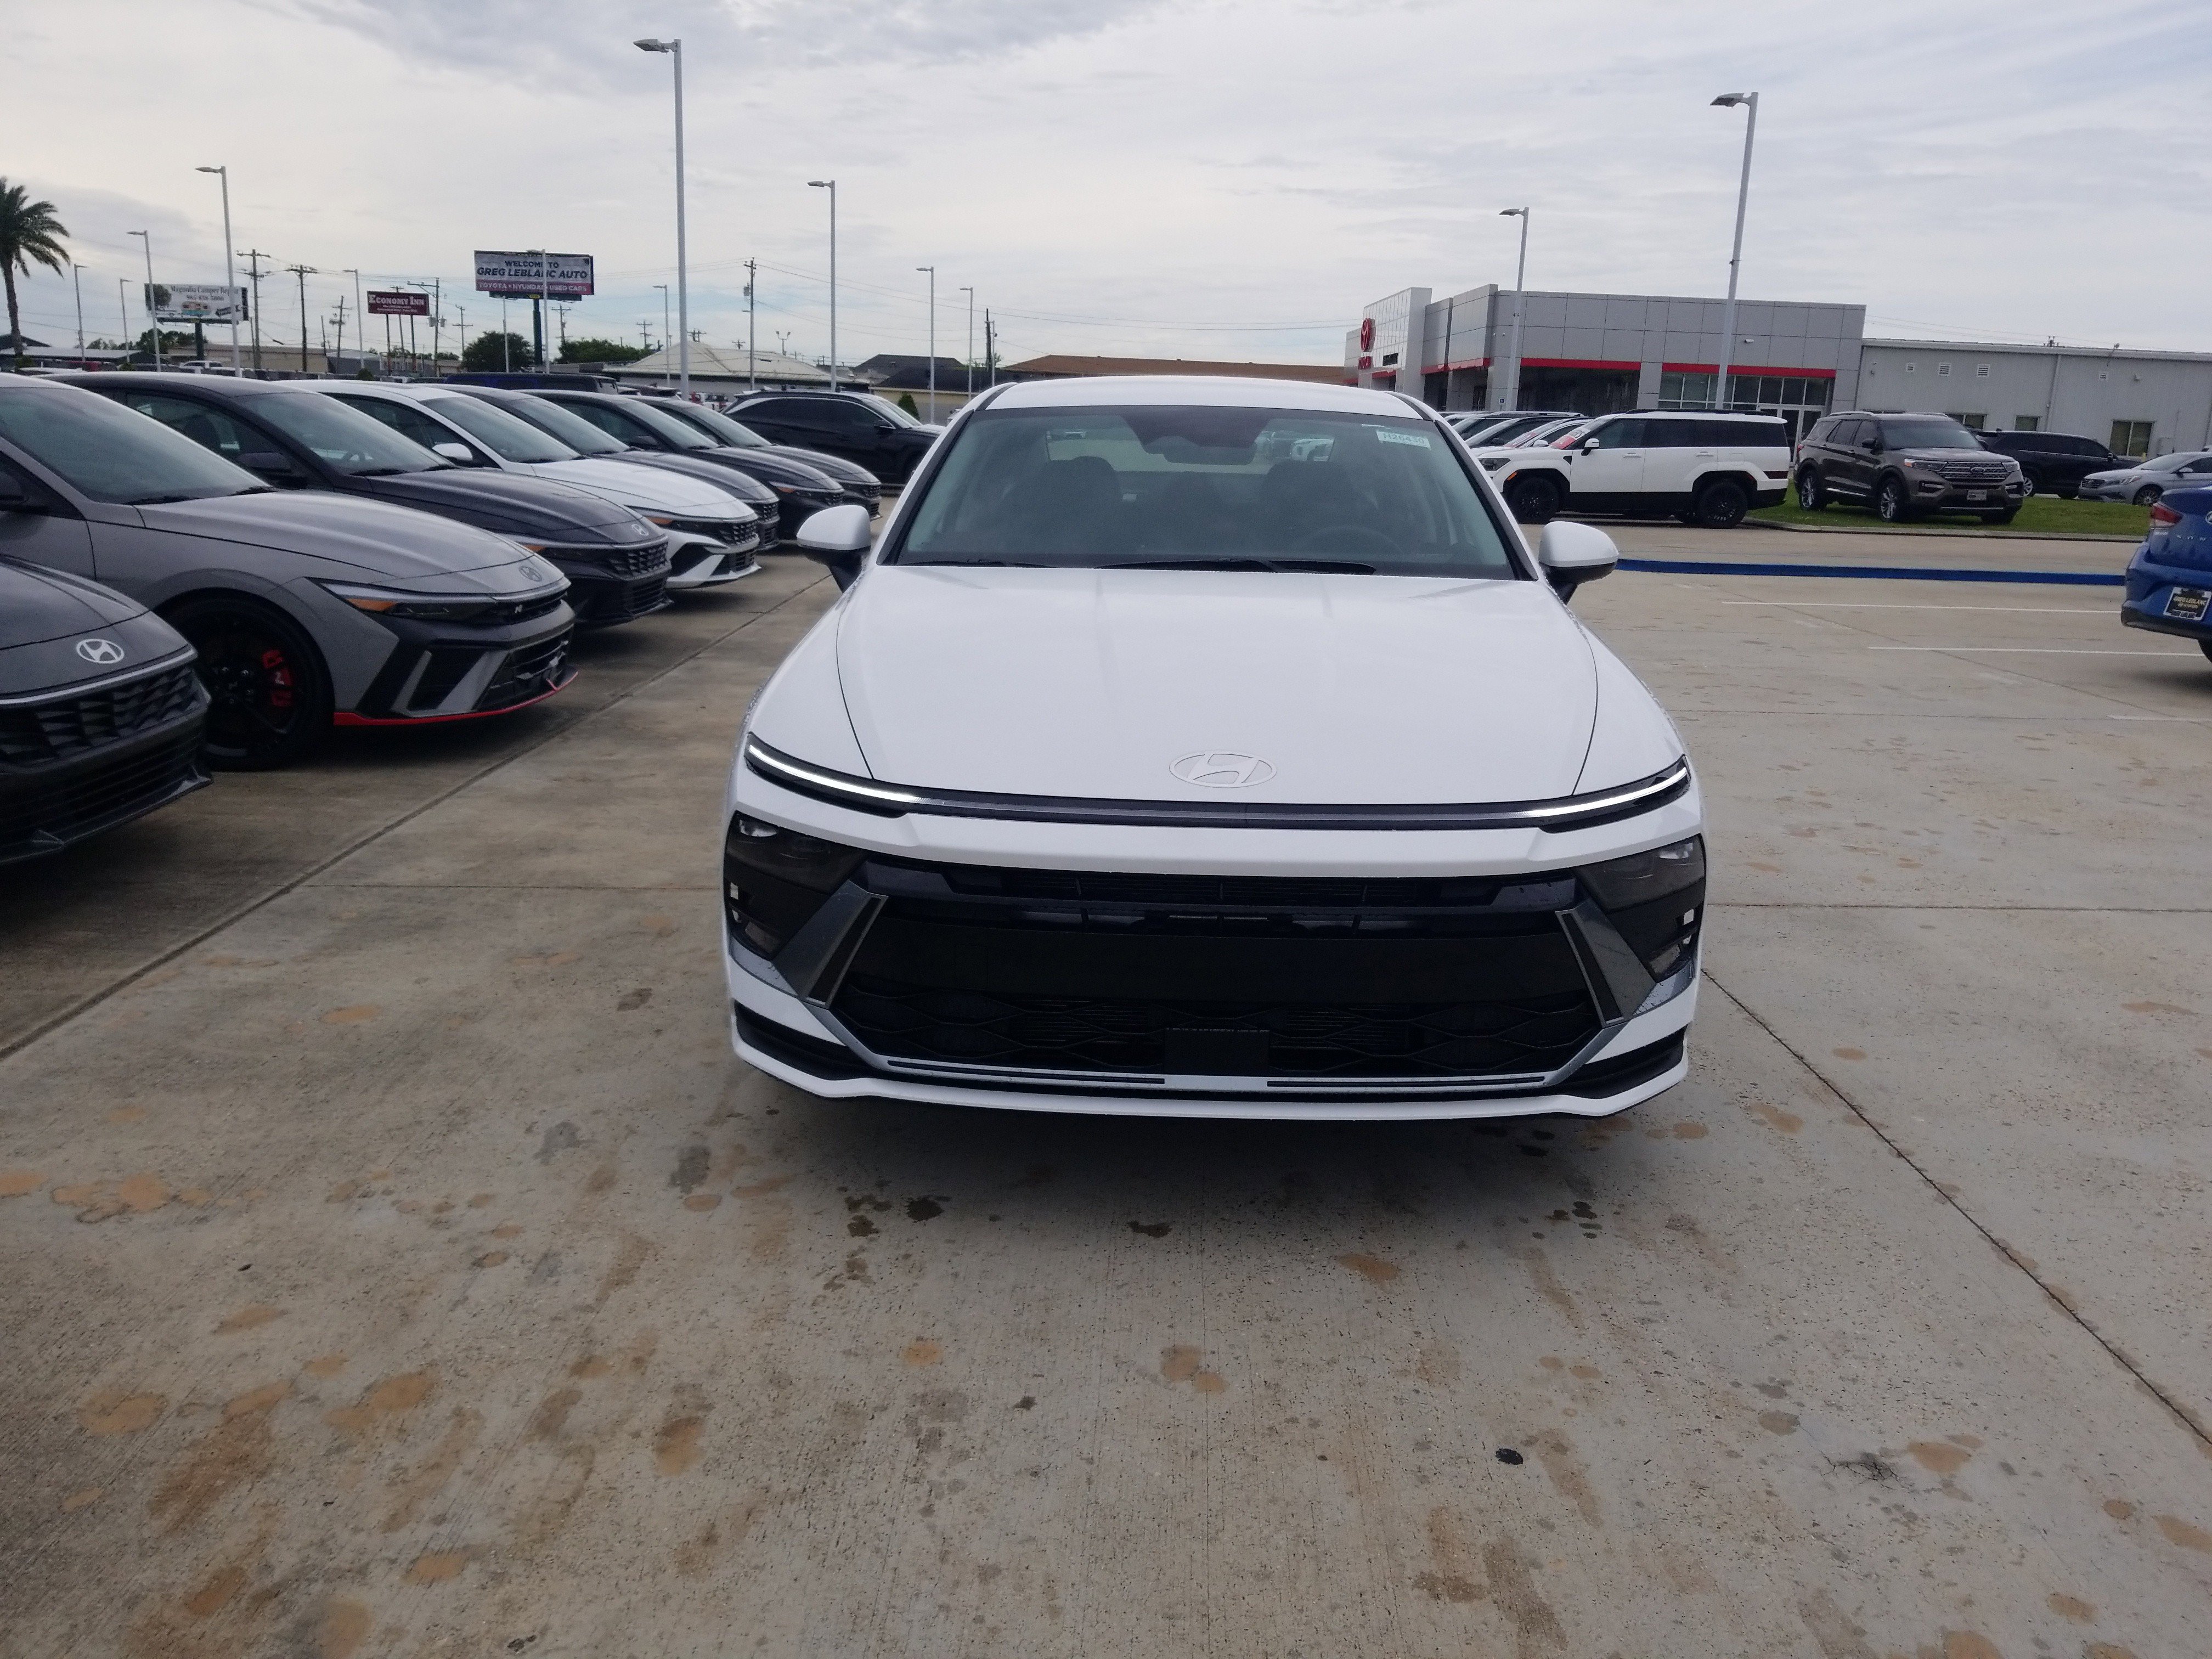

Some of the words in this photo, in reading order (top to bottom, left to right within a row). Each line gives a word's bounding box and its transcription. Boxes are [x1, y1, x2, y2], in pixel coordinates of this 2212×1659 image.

[477, 267, 505, 276] GREG
[558, 270, 588, 279] AUTO
[221, 287, 238, 296] Repir
[369, 295, 409, 305] ECONOMY
